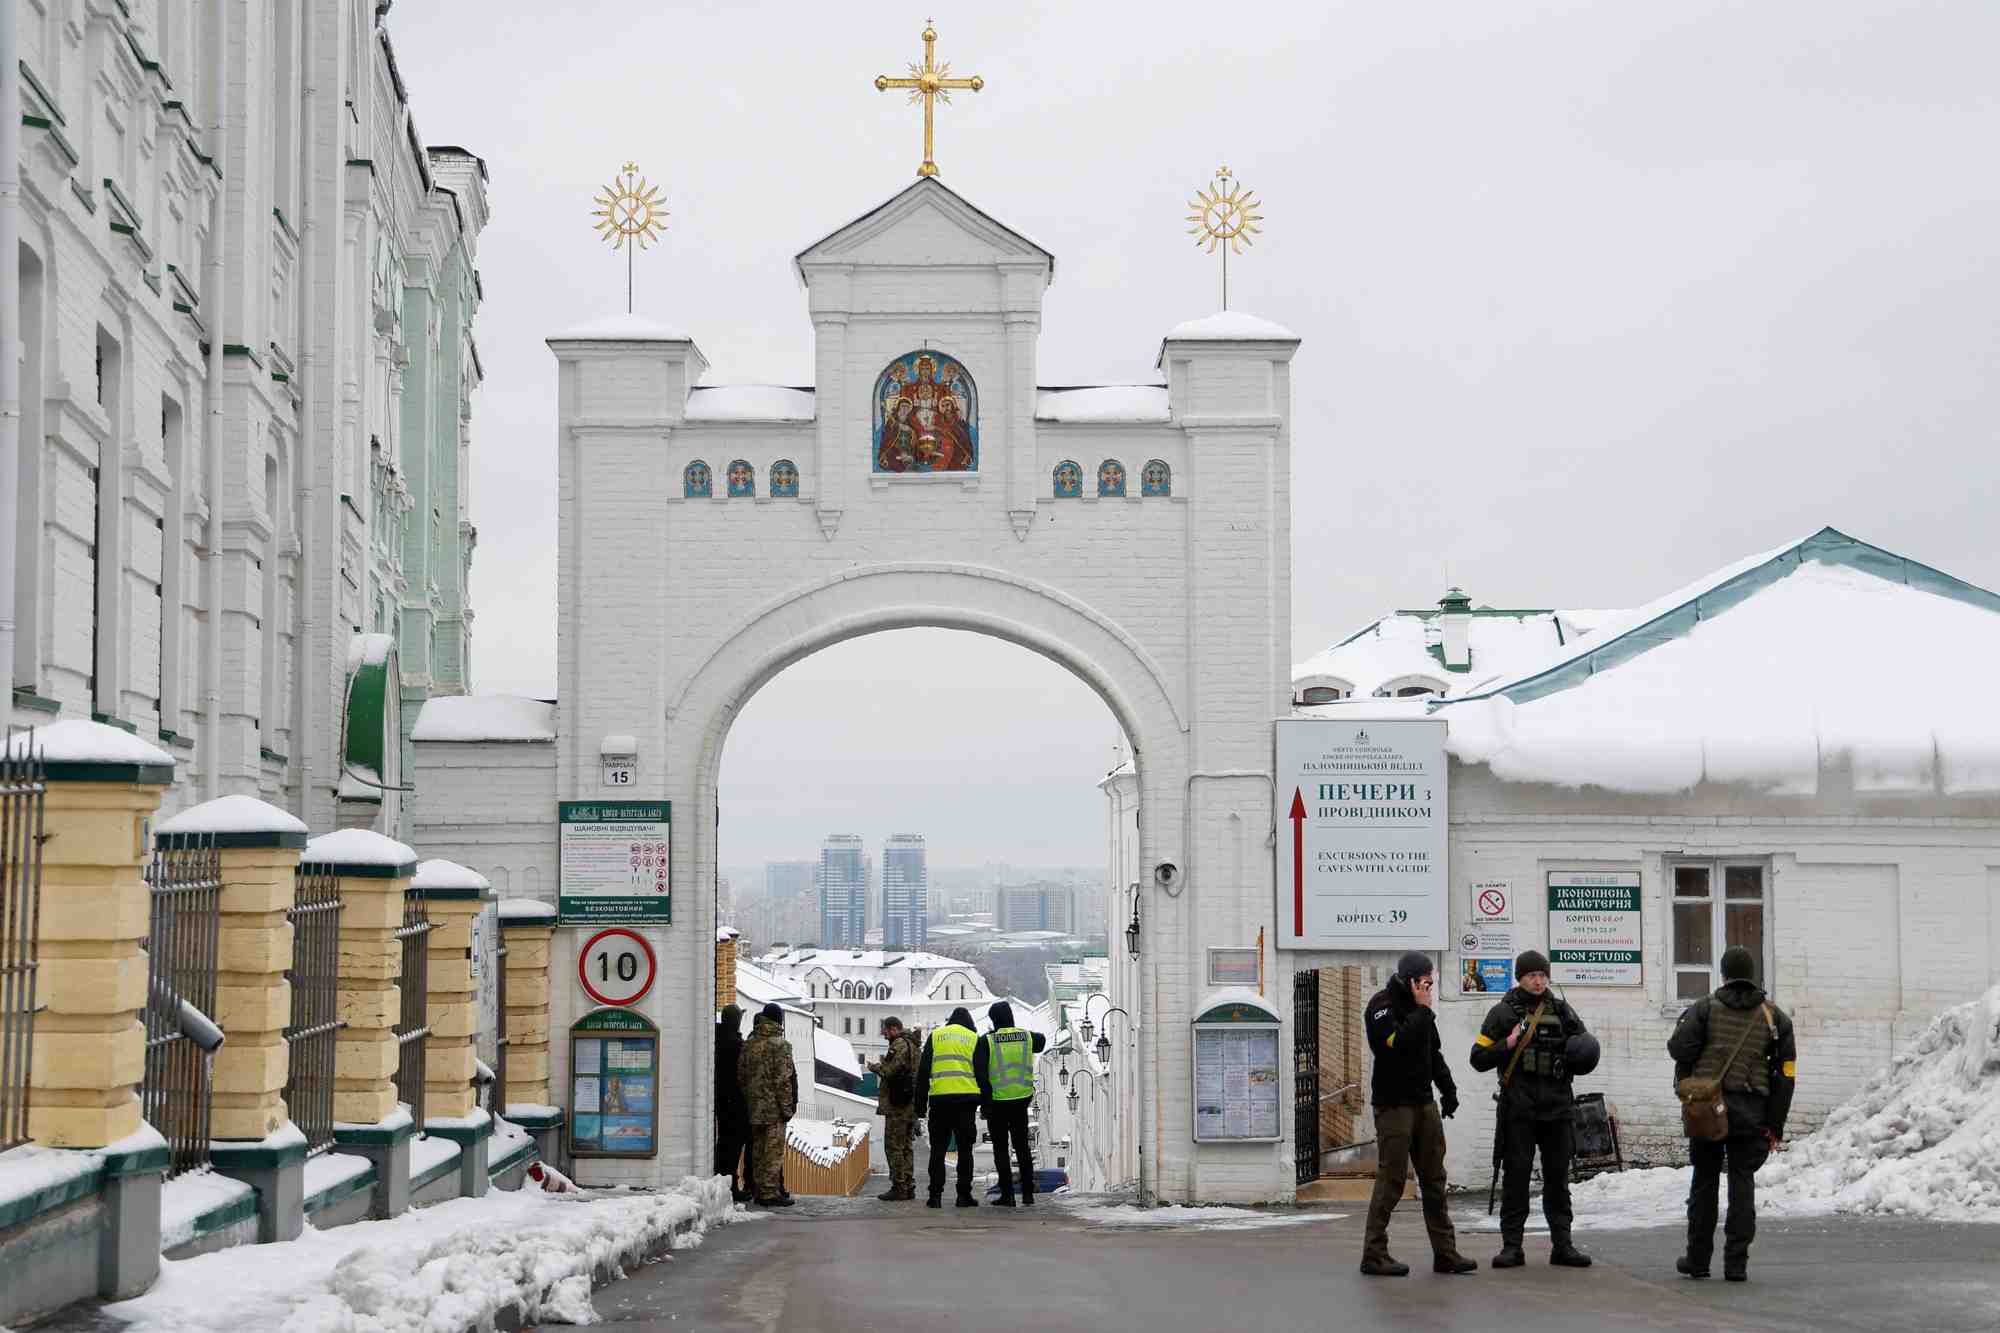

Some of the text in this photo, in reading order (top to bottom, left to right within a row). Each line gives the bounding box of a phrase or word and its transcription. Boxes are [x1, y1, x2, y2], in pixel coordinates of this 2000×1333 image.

[611, 771, 629, 783] 15
[1319, 783, 1416, 801] ПЕЧЕРИ
[1318, 806, 1432, 820] ПРОВІДНИКОМ
[1318, 851, 1430, 861] EXCURSIONS TO THE
[1318, 864, 1432, 873] CAVES WITH A GUIDE
[1557, 888, 1632, 898] ІКОНОПИСНА
[1557, 898, 1632, 909] МАЙСТЕРНЯ
[1337, 910, 1408, 923] КОРПУС 39
[1559, 951, 1633, 962] ICON STUDIO
[596, 951, 637, 982] 10
